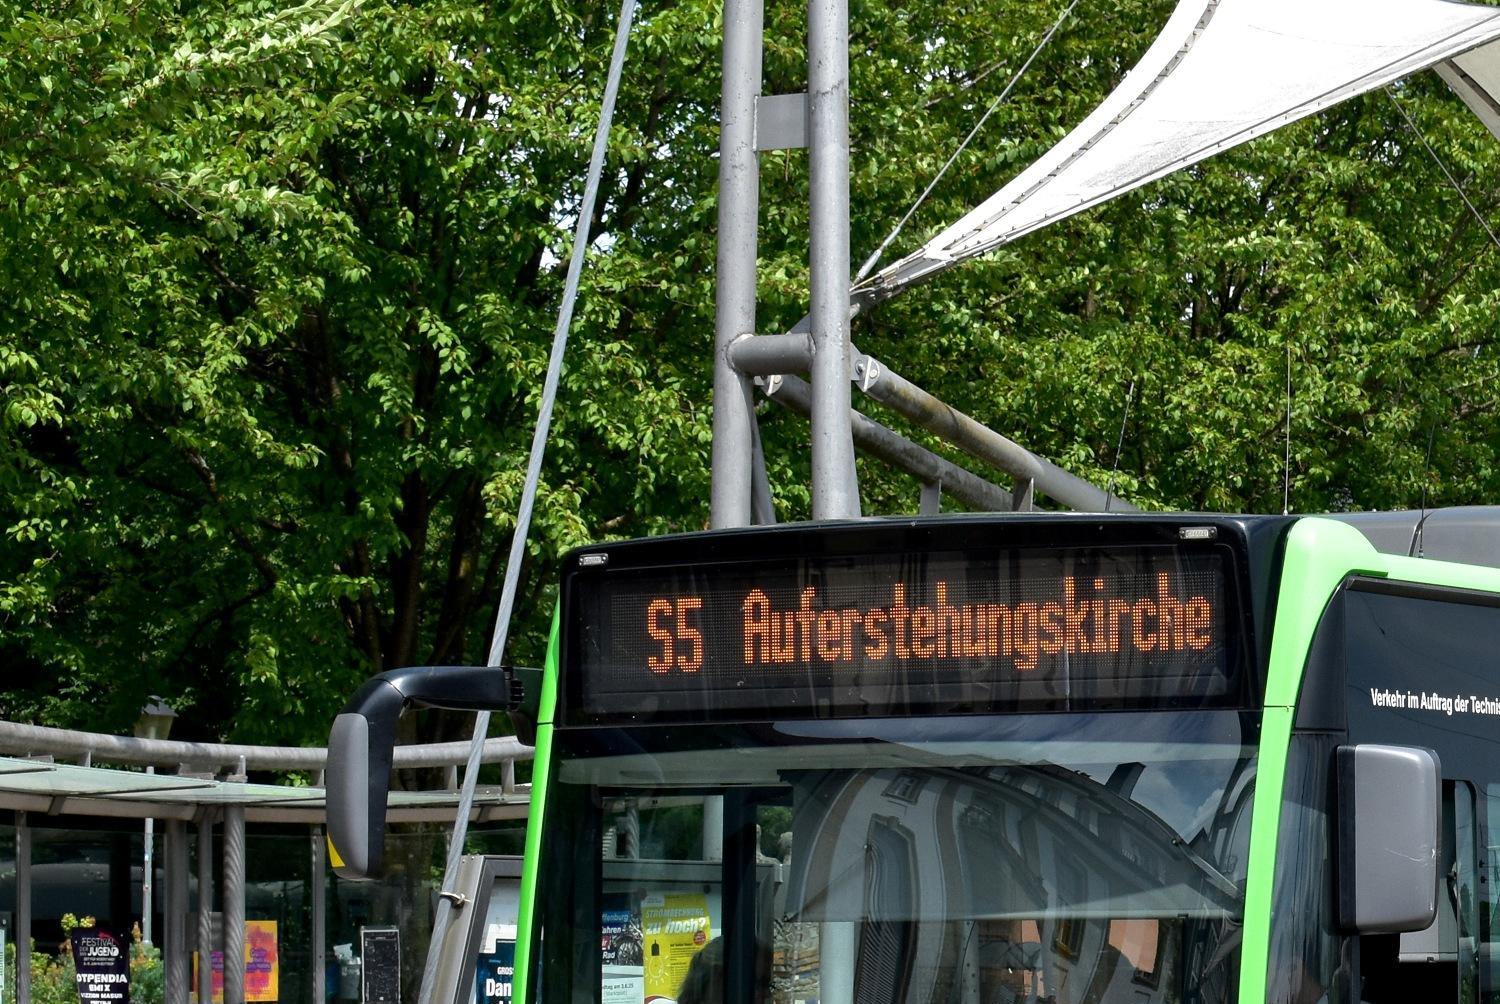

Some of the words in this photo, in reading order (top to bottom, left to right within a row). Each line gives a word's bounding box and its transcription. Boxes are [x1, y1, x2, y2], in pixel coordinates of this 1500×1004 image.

[647, 596, 702, 674] S5
[744, 573, 1211, 670] Auferstehungskirche
[1370, 687, 1406, 708] Verkehr
[1408, 691, 1418, 709] im
[1420, 692, 1453, 716] Auftrag
[1454, 695, 1468, 713] der
[81, 937, 117, 946] FESTIVAL
[87, 946, 119, 957] JUGEND
